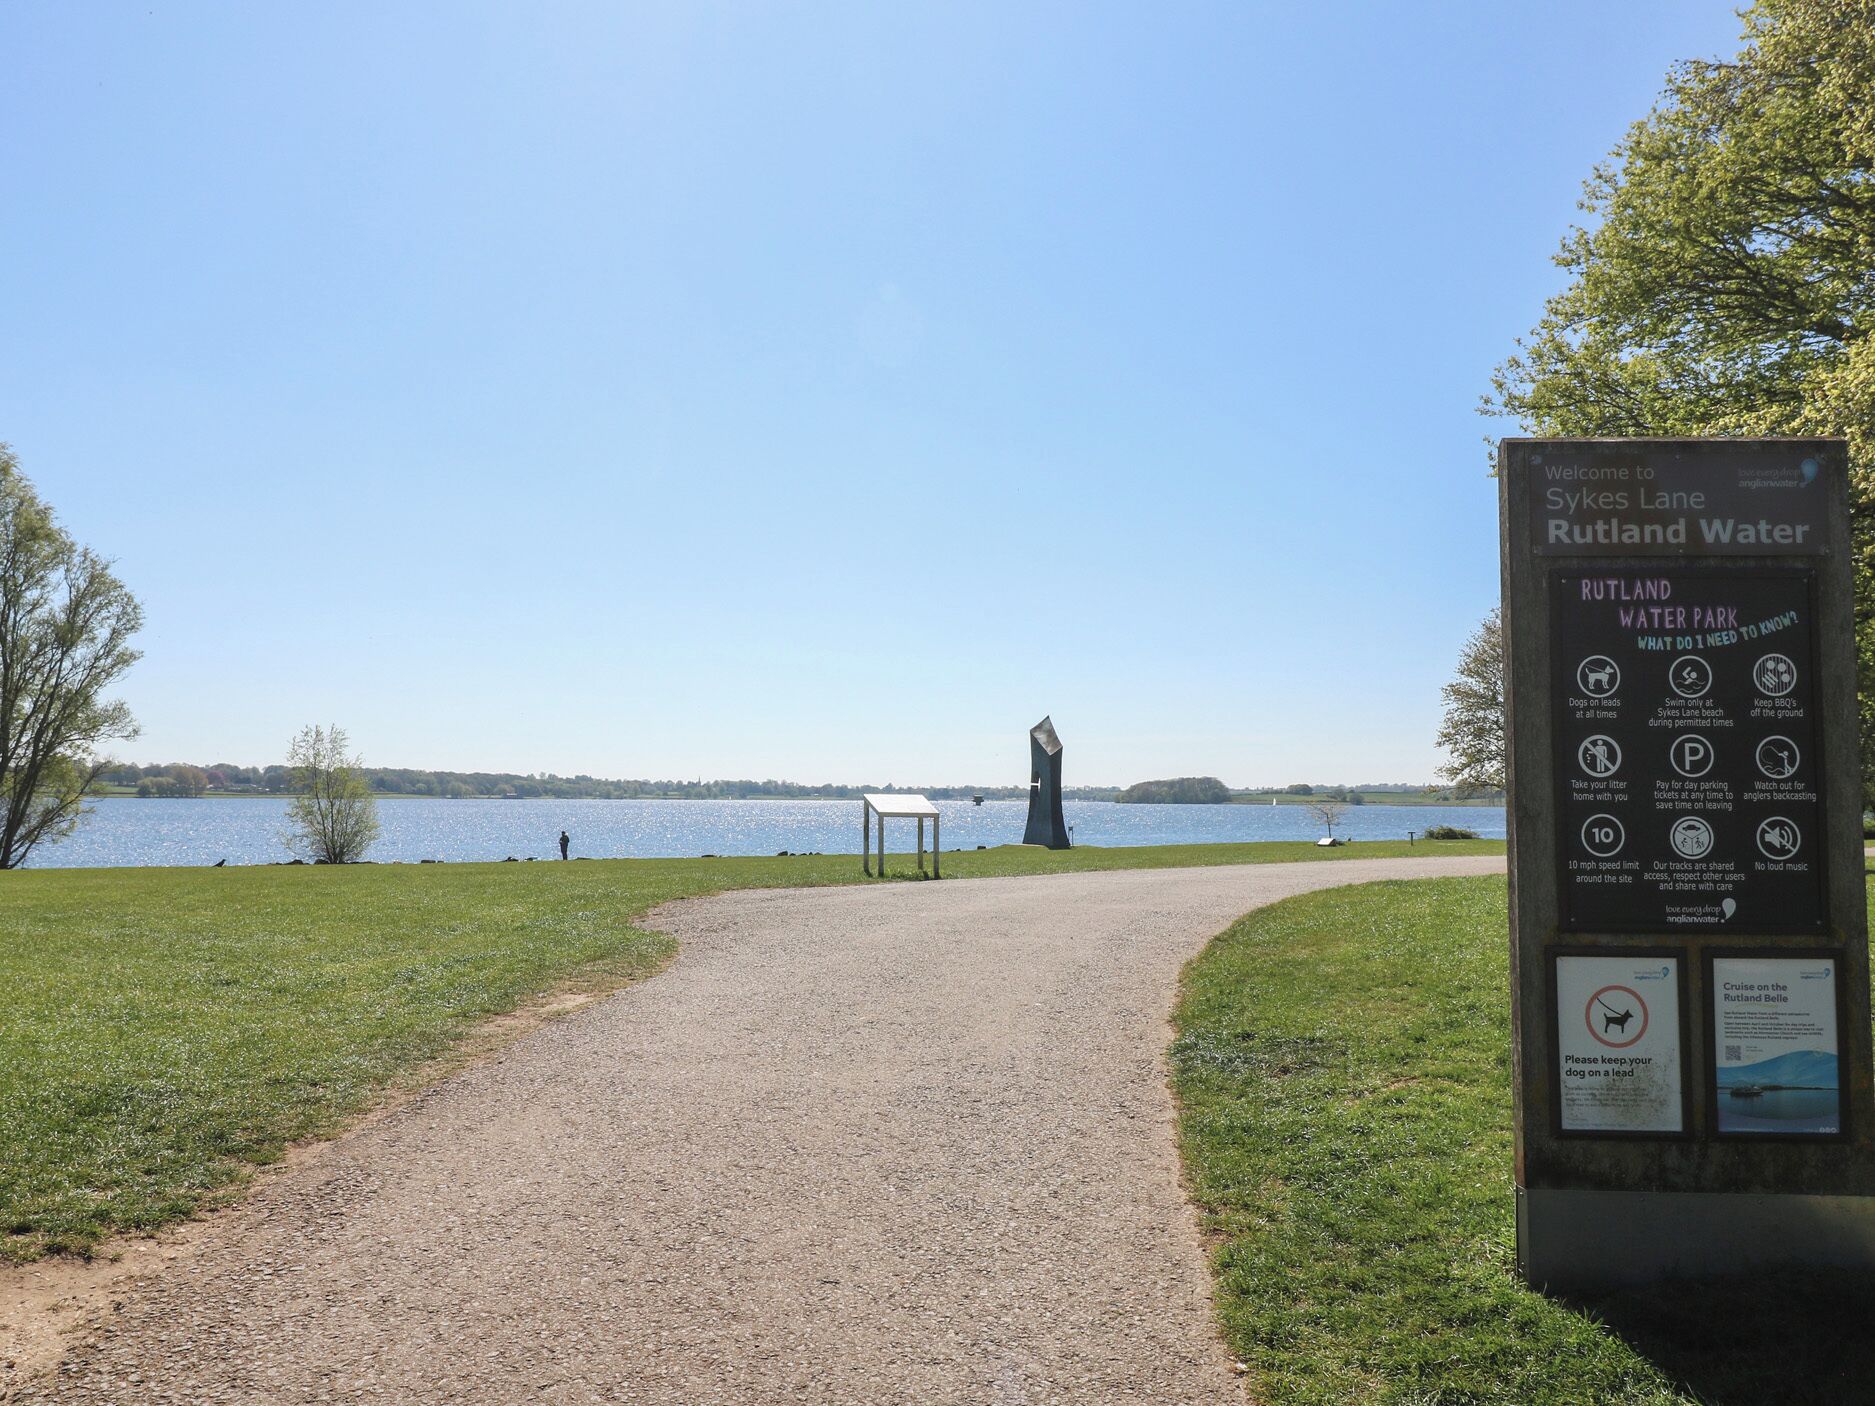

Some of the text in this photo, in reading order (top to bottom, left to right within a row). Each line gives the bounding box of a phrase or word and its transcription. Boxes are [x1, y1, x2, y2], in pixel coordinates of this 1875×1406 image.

[1546, 465, 1654, 480] Welcome to
[1546, 488, 1705, 514] Sykes Lane
[1548, 518, 1809, 544] Rutland Water
[1581, 579, 1671, 600] RUTLAND
[1619, 608, 1738, 629] WATER PARK
[1638, 610, 1800, 651] WHAT DO I NEED TO KNOW?
[1569, 698, 1588, 708] Dogs
[1601, 698, 1620, 707] leads
[1665, 698, 1687, 707] Swim
[1688, 698, 1704, 709] only
[1755, 698, 1796, 708] Keep BBQ's
[1585, 709, 1593, 718] all
[1595, 710, 1617, 718] times
[1658, 708, 1724, 718] Sykes Lane beach
[1751, 708, 1803, 719] off the ground
[1649, 718, 1733, 728] during permitted times
[1685, 743, 1704, 770] P
[1571, 780, 1627, 791] Take your litter
[1656, 781, 1728, 791] Pay for day parking
[1755, 781, 1778, 790] Watch
[1794, 781, 1805, 790] for
[1574, 792, 1628, 802] home with you
[1654, 791, 1679, 799] tickets
[1691, 793, 1704, 801] any
[1706, 791, 1723, 800] time
[1744, 792, 1816, 802] anglers backcasting
[1675, 801, 1692, 809] time
[1705, 801, 1732, 812] leaving
[1592, 828, 1613, 843] 10
[1569, 861, 1639, 872] 10 mph speed limit
[1654, 862, 1667, 870] Our
[1669, 862, 1693, 870] tracks
[1709, 862, 1734, 870] shared
[1755, 862, 1808, 871] No loud music
[1576, 874, 1632, 883] around the site
[1644, 873, 1670, 882] access,
[1673, 873, 1701, 882] respect
[1703, 872, 1723, 881] other
[1659, 882, 1674, 890] and
[1675, 882, 1697, 891] share
[1699, 882, 1714, 890] with
[1682, 906, 1702, 915] every
[1703, 905, 1721, 915] drop
[1666, 915, 1719, 923] anglianwater
[1724, 982, 1755, 991] Cruise
[1771, 983, 1787, 991] the
[1724, 994, 1788, 1003] Rutland Belle
[1565, 1055, 1652, 1067] Please keep your
[1566, 1068, 1585, 1079] dog
[1612, 1068, 1634, 1077] lead
